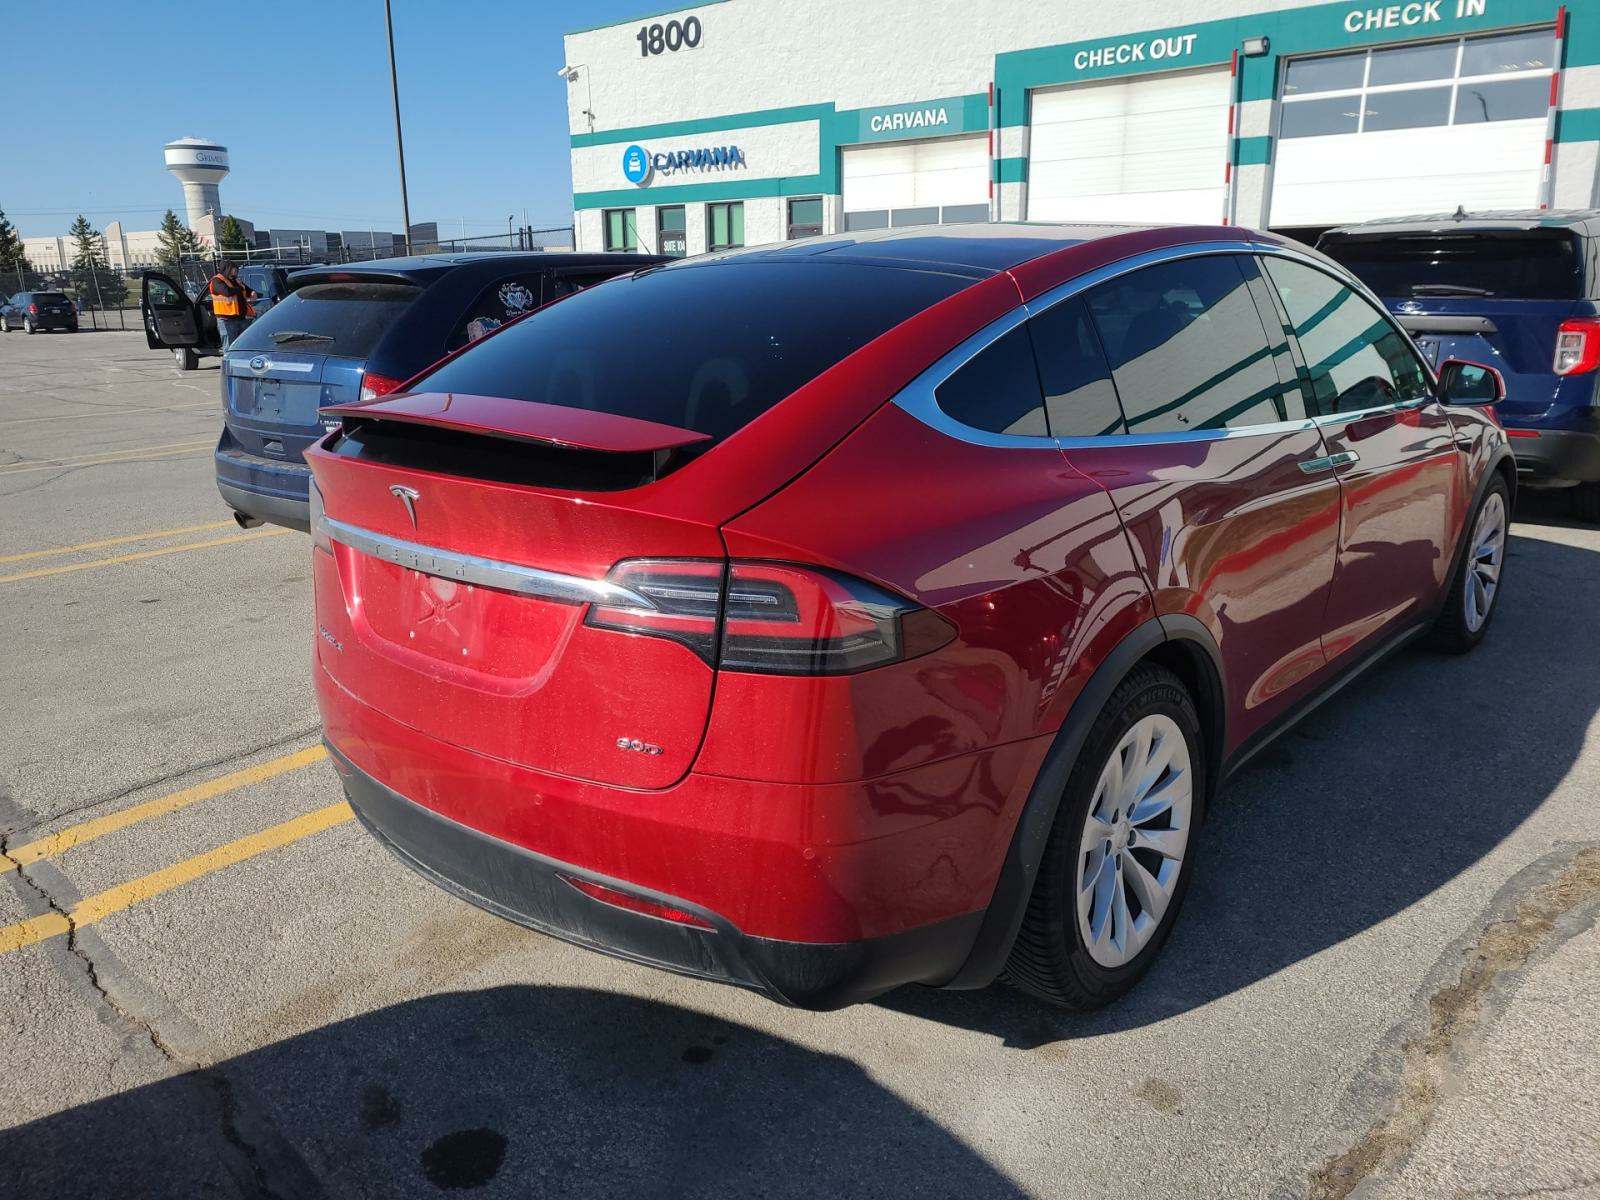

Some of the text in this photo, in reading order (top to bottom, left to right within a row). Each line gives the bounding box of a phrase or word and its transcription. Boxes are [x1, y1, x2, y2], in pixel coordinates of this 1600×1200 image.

[1344, 0, 1486, 33] CHECK IN
[636, 15, 702, 57] 1800
[1074, 34, 1197, 70] CHECK OUT
[871, 107, 949, 133] CARVANA
[652, 145, 745, 172] CARVANA
